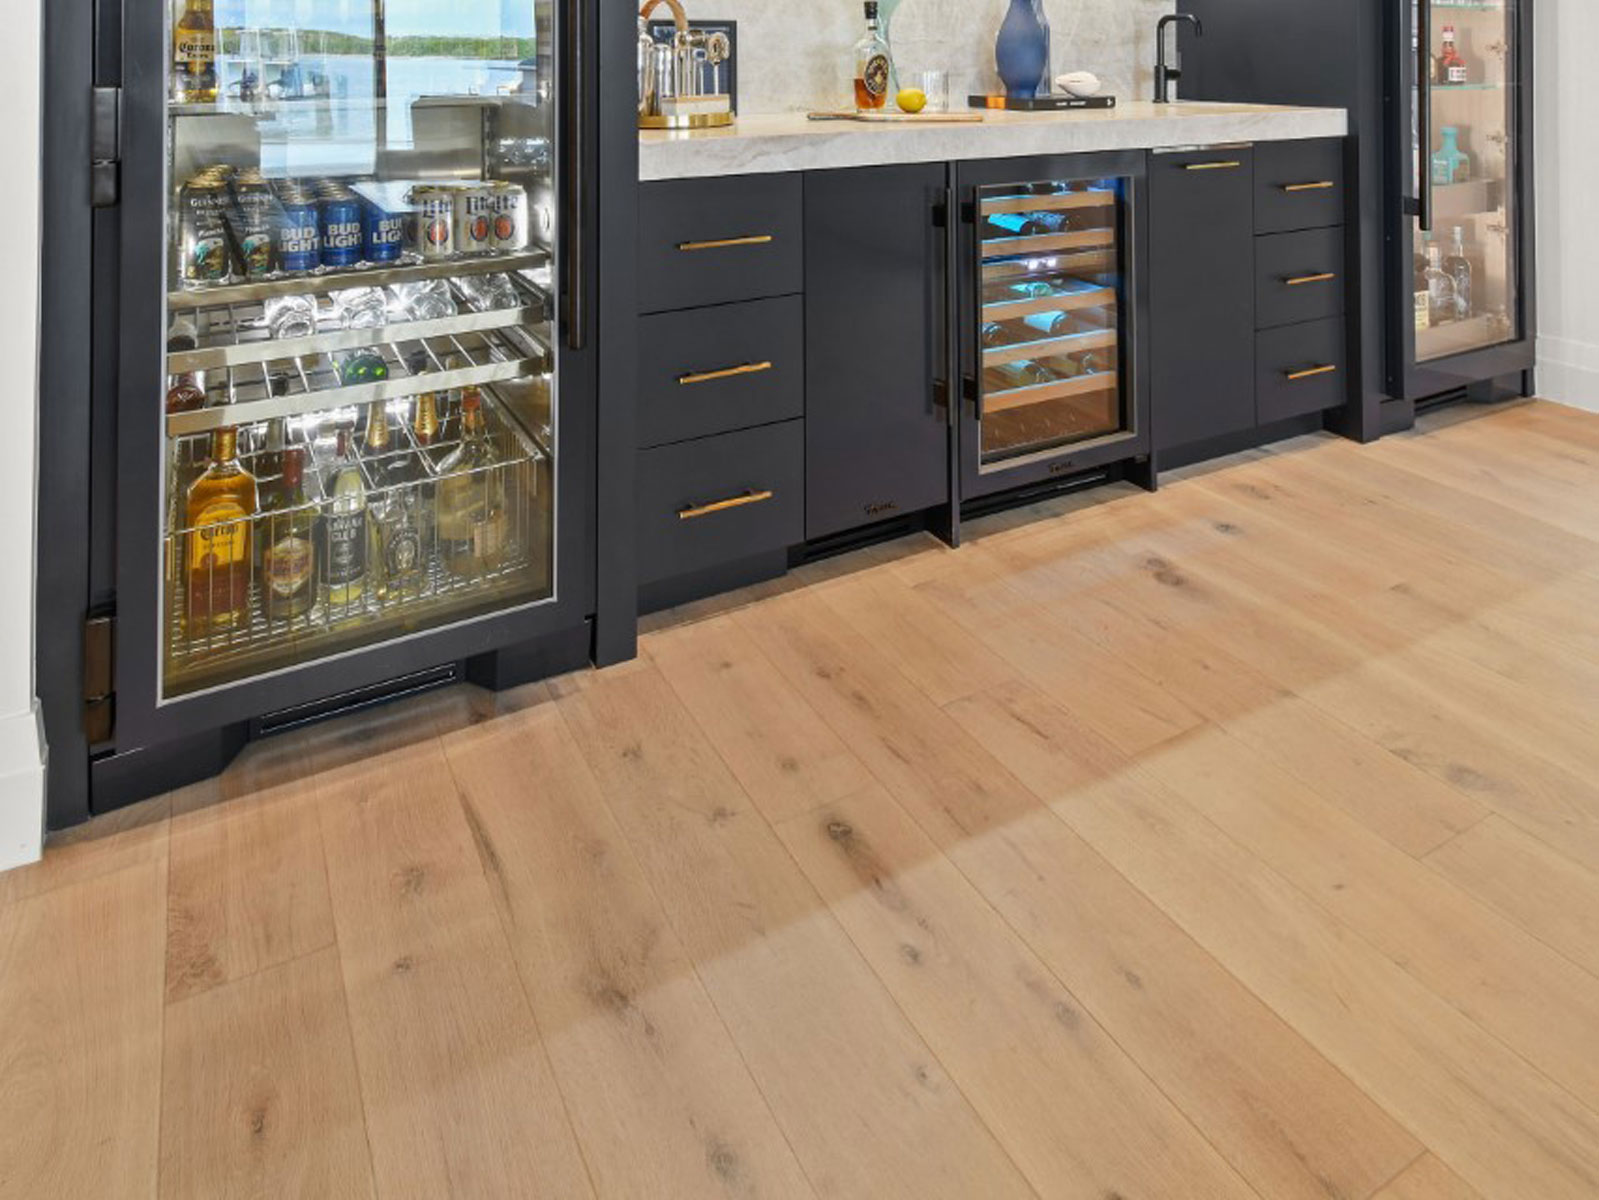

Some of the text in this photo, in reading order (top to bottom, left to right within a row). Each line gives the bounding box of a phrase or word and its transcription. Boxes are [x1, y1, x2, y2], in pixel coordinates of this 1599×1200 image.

[328, 222, 360, 237] BUD
[379, 218, 402, 232] BU
[281, 227, 315, 241] BUD
[323, 231, 362, 249] LIGHT
